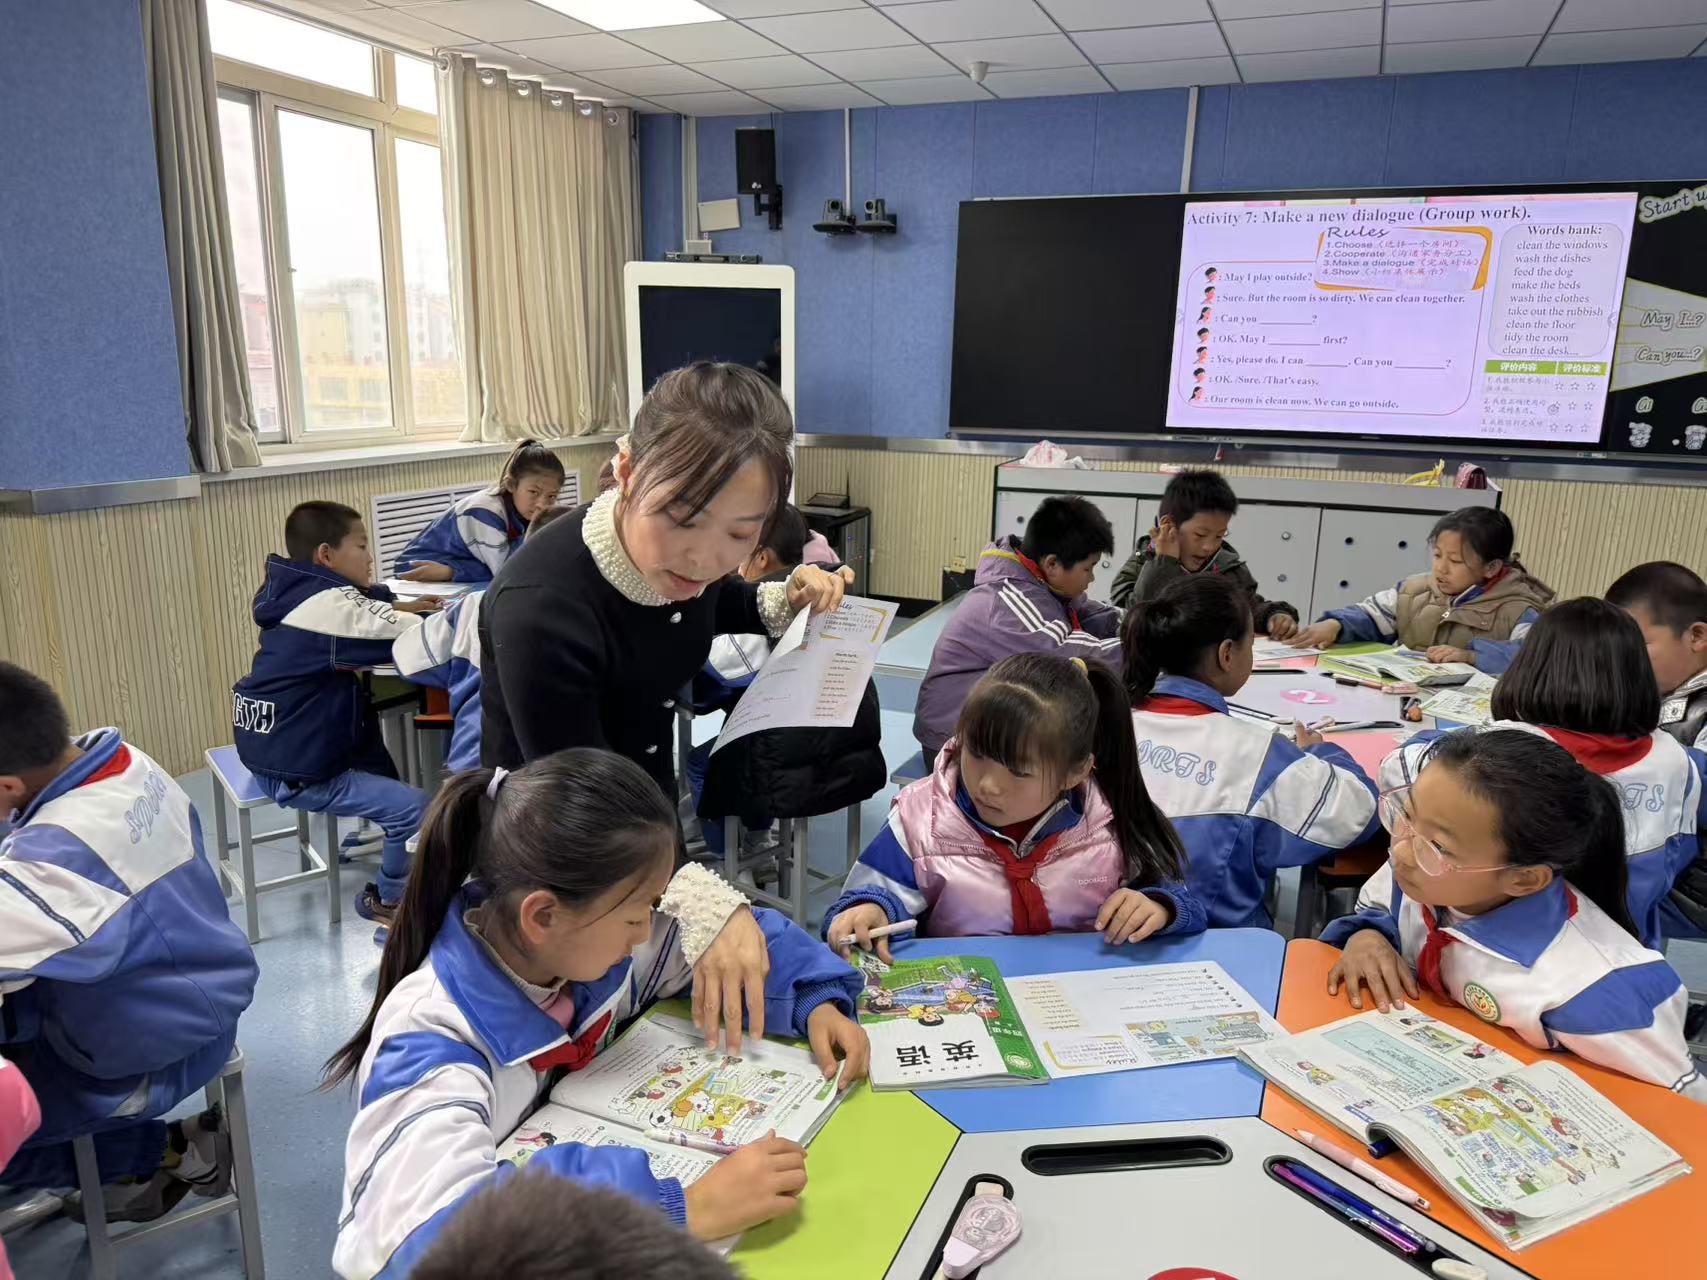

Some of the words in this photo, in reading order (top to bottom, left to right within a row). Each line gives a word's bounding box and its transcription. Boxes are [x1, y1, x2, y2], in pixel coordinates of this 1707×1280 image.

[1644, 193, 1690, 218] Start
[1188, 212, 1241, 227] Activity
[1245, 212, 1257, 223] 7:
[1262, 211, 1301, 223] Make
[1306, 214, 1314, 222] a
[1319, 212, 1348, 222] new
[1352, 208, 1415, 223] dialogue
[1419, 207, 1475, 222] (Group
[1480, 206, 1531, 220] work).
[1328, 226, 1391, 238] Rules
[1527, 225, 1564, 235] Words
[1568, 225, 1602, 235] bank:
[1327, 241, 1373, 249] 1.Choose
[1517, 241, 1542, 250] clean
[1545, 241, 1560, 250] the
[1564, 240, 1608, 249] windows
[1324, 250, 1385, 258] 2.Cooperate
[1515, 254, 1540, 263] wash
[1543, 254, 1558, 263] the
[1560, 254, 1592, 263] dishes
[1372, 260, 1415, 268] dialogue
[1322, 268, 1360, 276] 4.Show
[1514, 267, 1535, 277] feed
[1537, 267, 1552, 277] the
[1554, 267, 1573, 278] dog
[1225, 273, 1244, 282] May
[1253, 273, 1271, 283] play
[1275, 273, 1313, 281] outside?
[1511, 281, 1538, 290] make
[1540, 281, 1556, 289] the
[1558, 281, 1581, 290] beds
[1248, 294, 1264, 302] But
[1266, 294, 1280, 302] the
[1282, 295, 1307, 303] room
[1309, 294, 1317, 303] is
[1331, 295, 1356, 305] dirty.
[1358, 295, 1374, 303] We
[1395, 295, 1420, 303] clean
[1423, 295, 1465, 304] together.
[1510, 294, 1535, 303] wash
[1537, 294, 1552, 303] the
[1555, 294, 1590, 303] clothes
[1508, 307, 1528, 316] take
[1530, 308, 1546, 316] out
[1549, 307, 1564, 316] the
[1566, 307, 1603, 317] rubbish
[1221, 315, 1239, 323] Can
[1241, 316, 1257, 325] you
[1506, 320, 1531, 329] clean
[1534, 320, 1549, 329] the
[1552, 320, 1576, 329] floor
[1643, 312, 1671, 328] May
[1240, 335, 1260, 345] May
[1323, 336, 1348, 344] first?
[1504, 332, 1523, 344] tidy
[1525, 332, 1541, 342] the
[1502, 345, 1528, 355] clean
[1530, 345, 1545, 355] the
[1638, 347, 1660, 361] Can
[1236, 356, 1263, 365] please
[1353, 357, 1373, 366] Can
[1375, 359, 1393, 368] you
[1297, 378, 1320, 386] easy.
[1210, 395, 1229, 403] Our
[1256, 396, 1264, 404] is
[1265, 396, 1288, 405] clean
[1314, 398, 1329, 406] We
[1331, 399, 1347, 407] can
[1349, 400, 1360, 408] go
[1362, 400, 1399, 409] outside.
[896, 1040, 980, 1068] 英语
